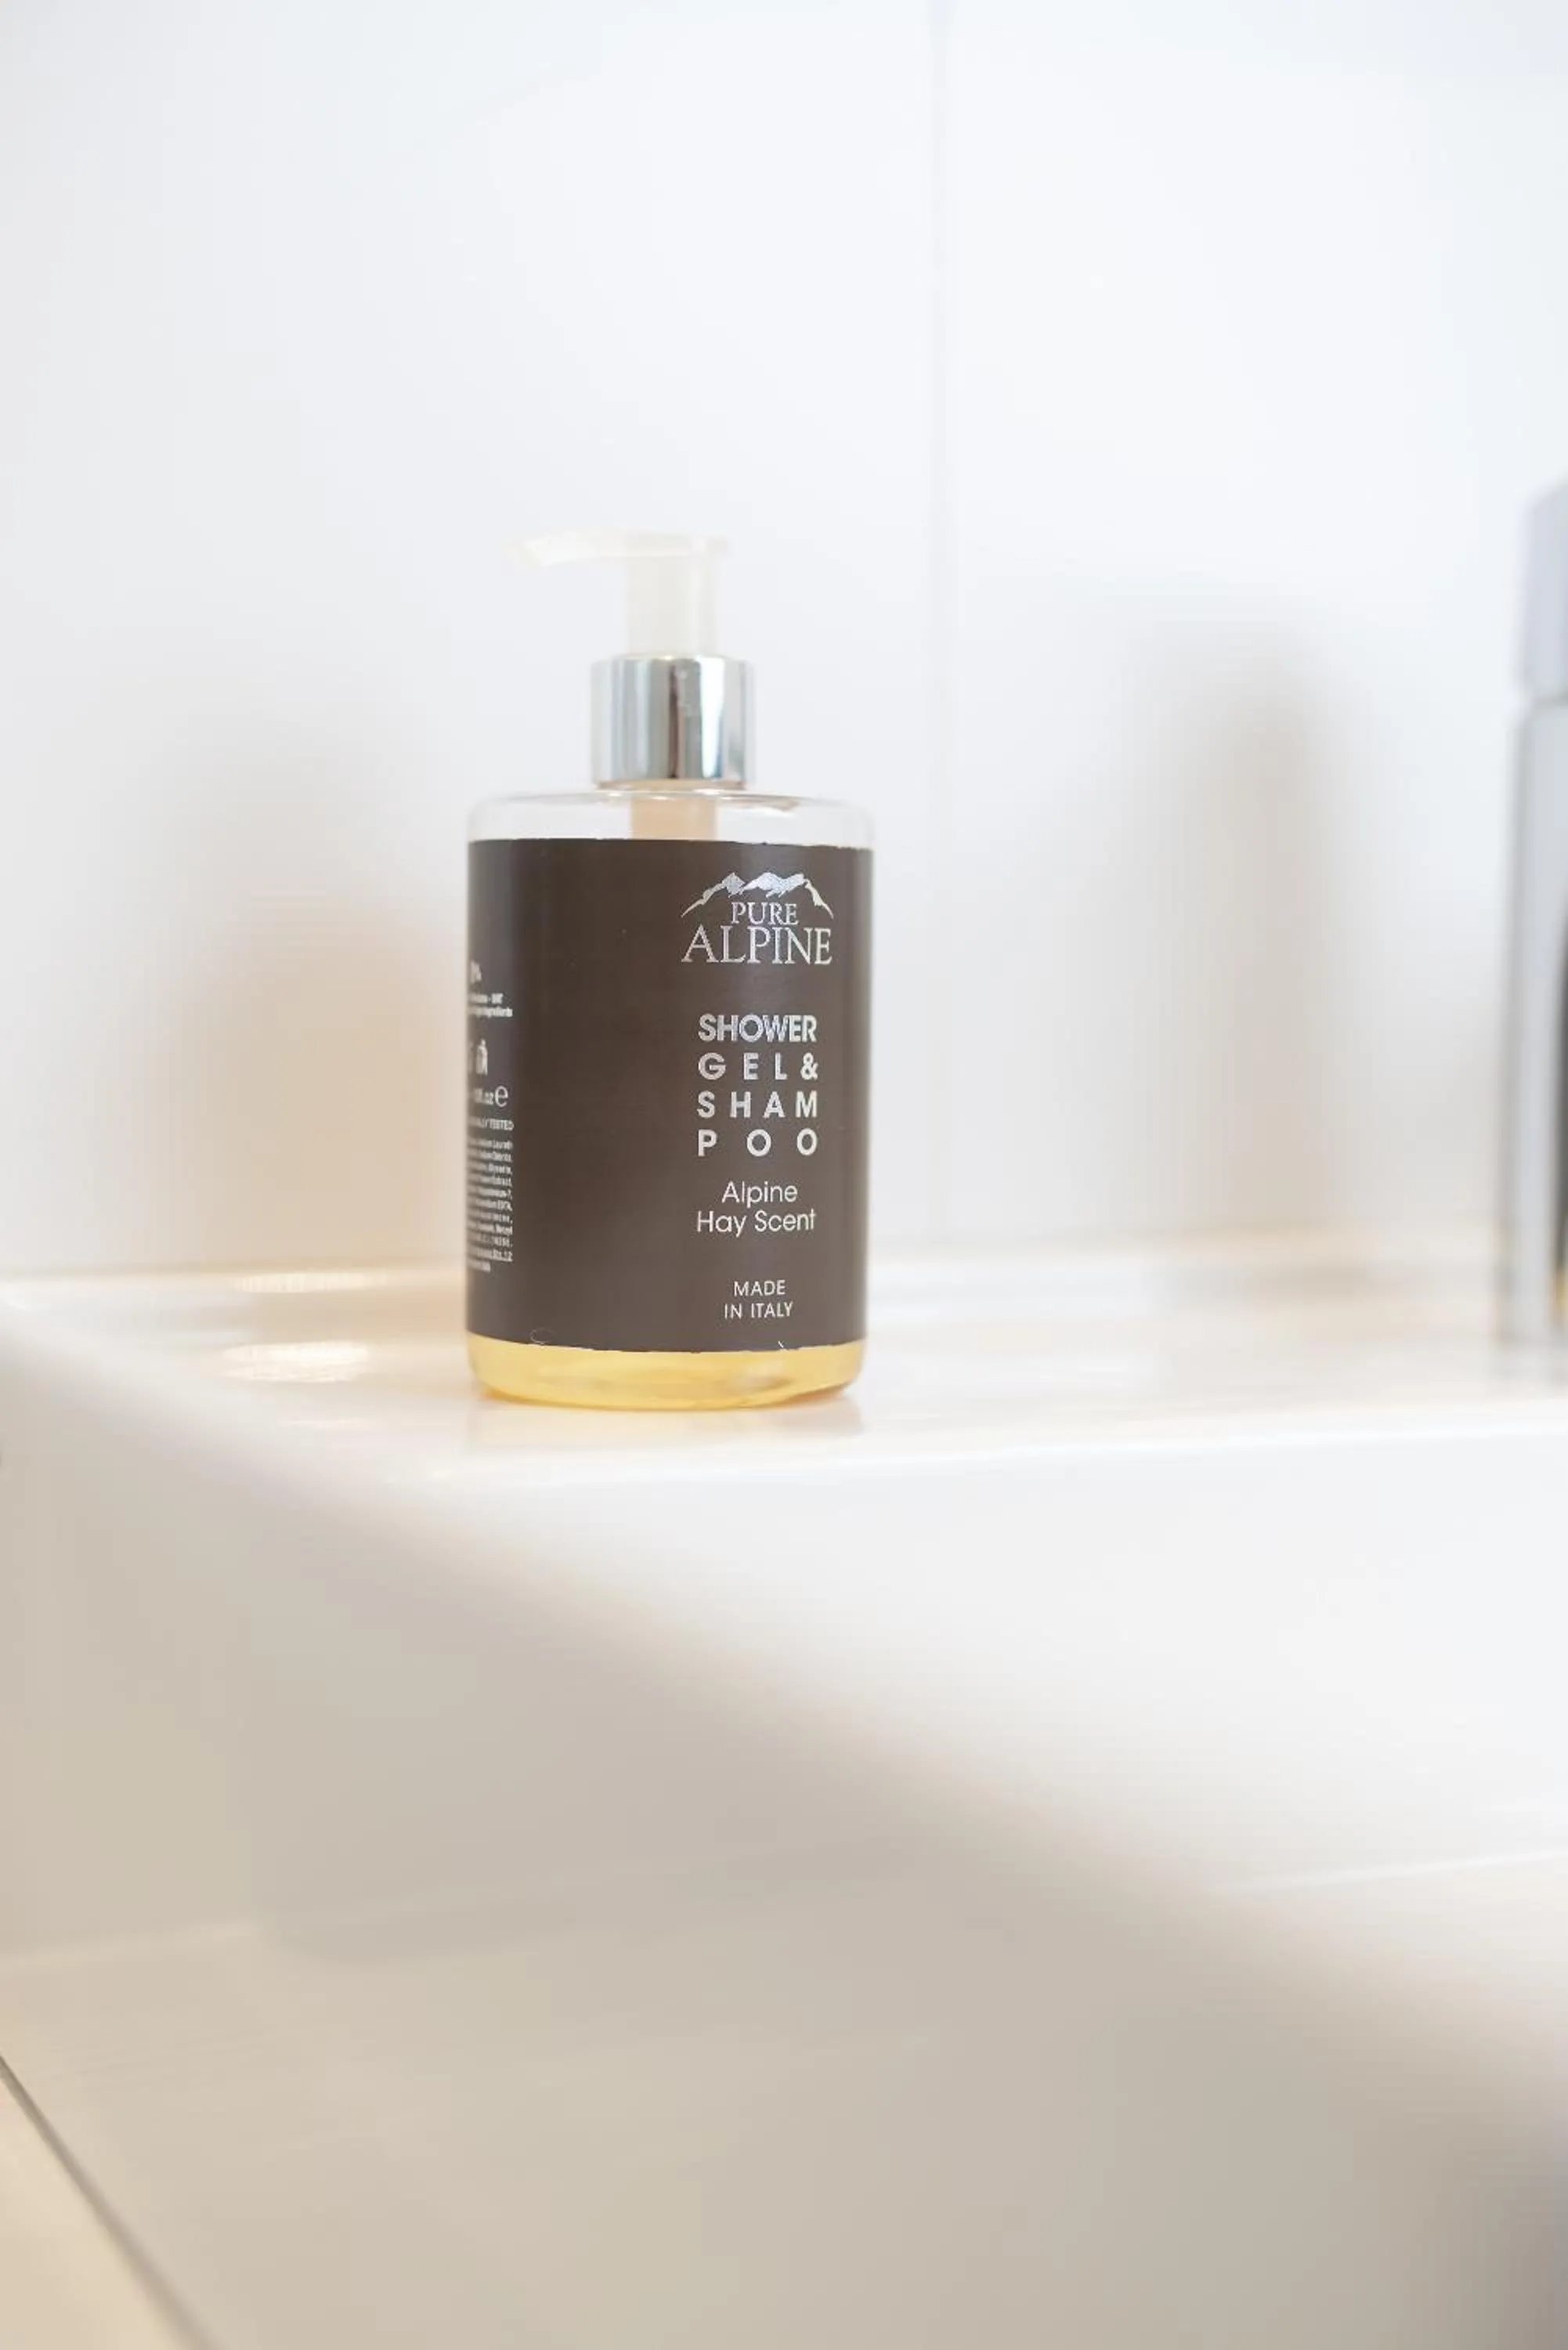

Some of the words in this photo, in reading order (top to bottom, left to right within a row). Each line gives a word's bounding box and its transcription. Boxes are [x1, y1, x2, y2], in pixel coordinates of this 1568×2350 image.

[731, 902, 799, 925] PURE
[681, 924, 833, 965] ALPINE
[698, 1014, 818, 1043] SHOWER
[697, 1090, 818, 1119] SHAM
[698, 1128, 818, 1157] POO
[721, 1181, 798, 1209] Alpine
[696, 1210, 747, 1238] Hay
[754, 1208, 816, 1232] Scent
[733, 1280, 786, 1297] MADE
[724, 1303, 742, 1320] IN
[751, 1301, 793, 1318] ITALY
